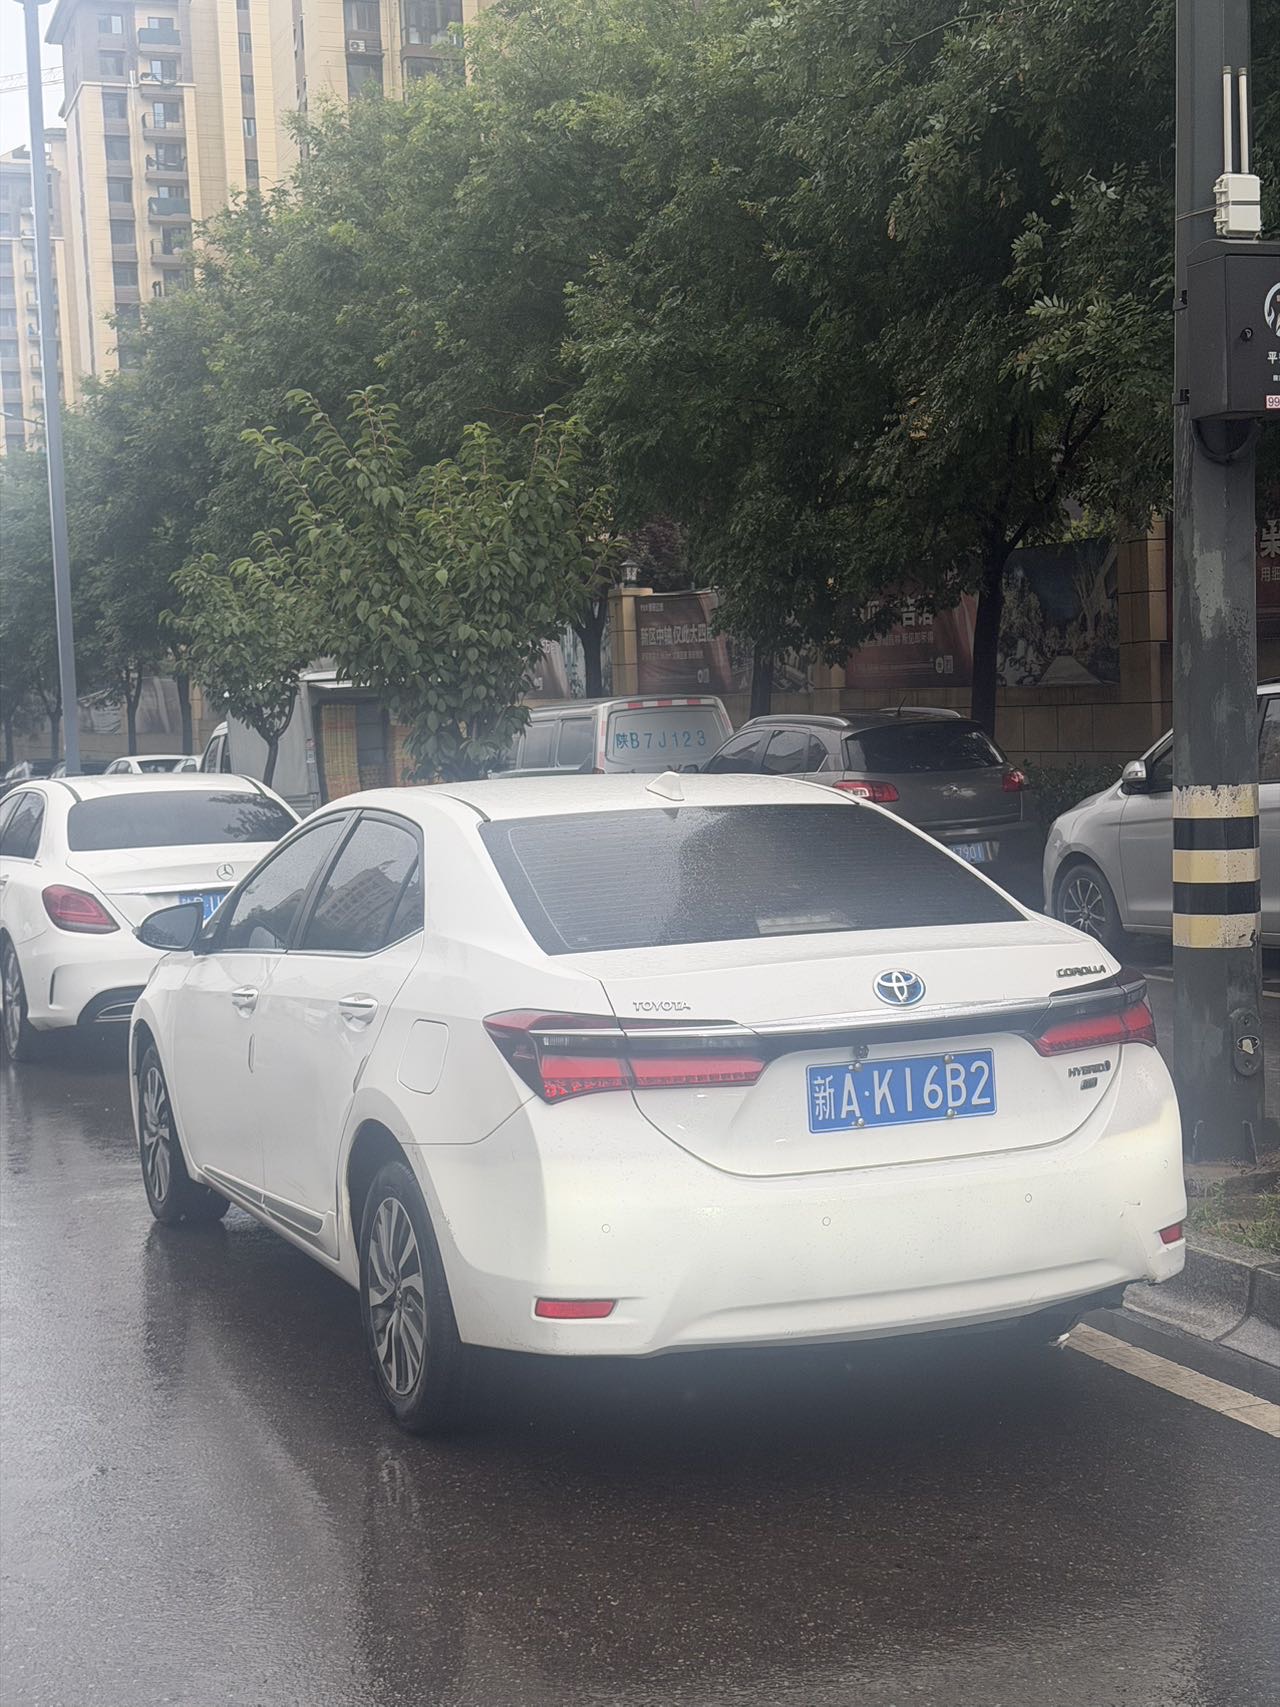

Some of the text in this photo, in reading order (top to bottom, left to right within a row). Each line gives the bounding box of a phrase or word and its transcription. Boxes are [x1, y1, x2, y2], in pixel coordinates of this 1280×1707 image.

[615, 730, 706, 750] 陕B7J123
[1056, 964, 1107, 979] COROLLA
[632, 1000, 691, 1012] TOYOTA
[1067, 1062, 1106, 1078] HYBRID
